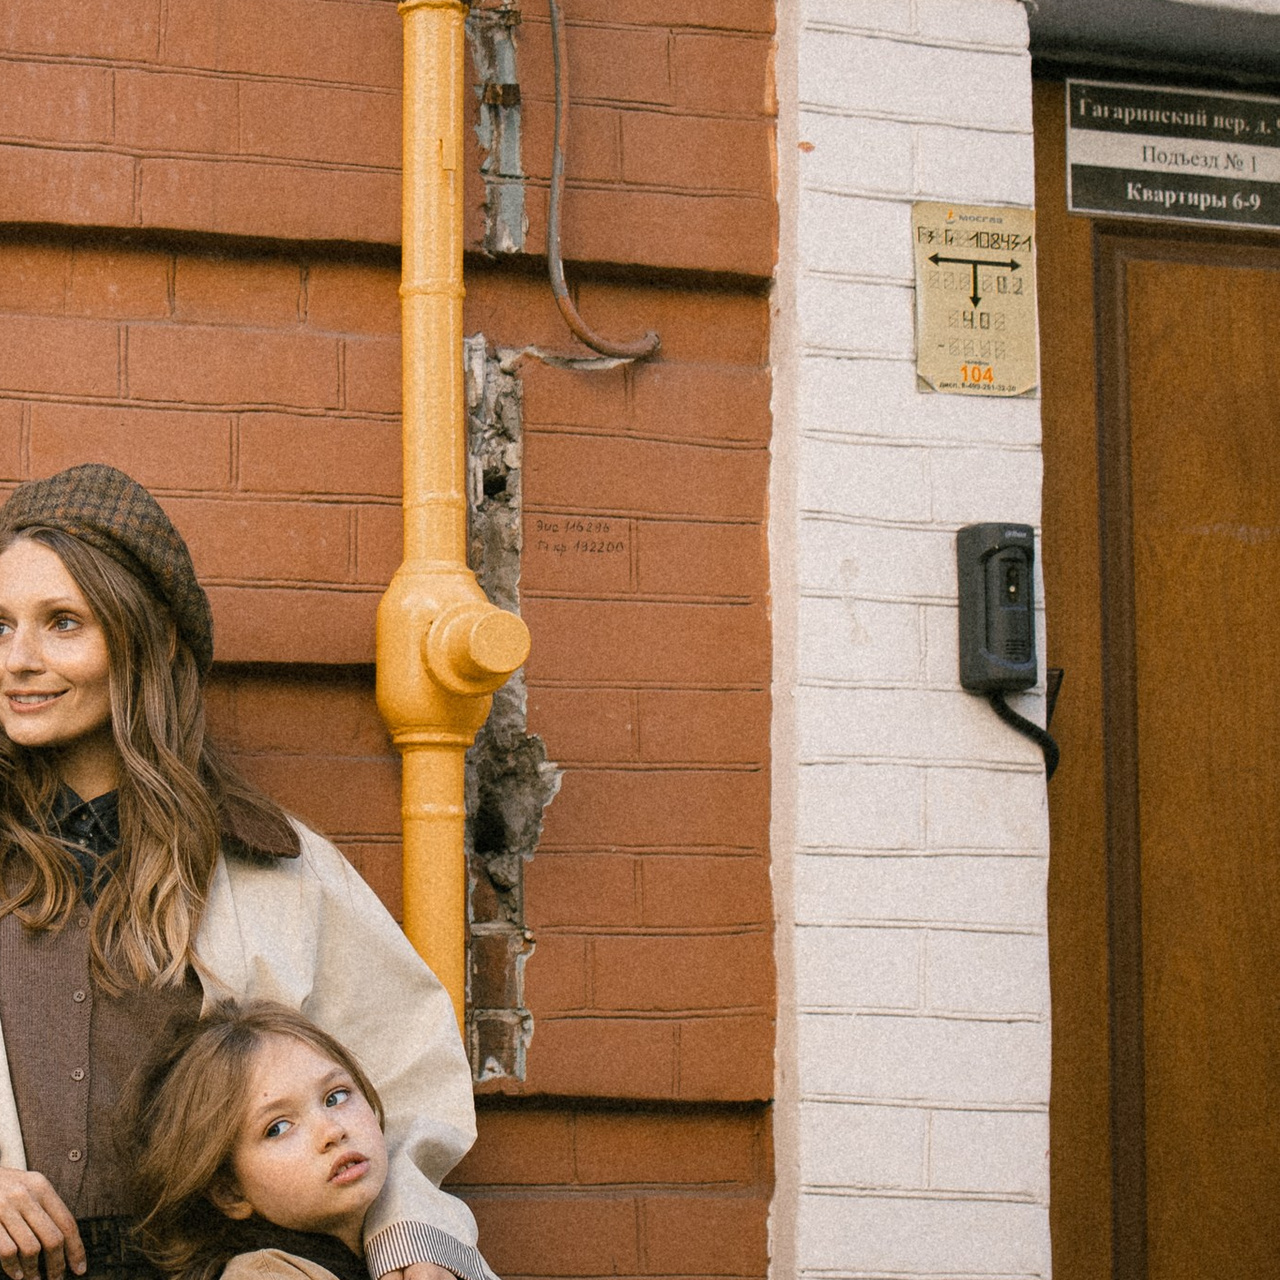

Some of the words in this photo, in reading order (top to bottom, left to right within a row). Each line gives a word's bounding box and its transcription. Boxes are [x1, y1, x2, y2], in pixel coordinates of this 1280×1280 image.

[1079, 98, 1207, 127] Гагаринский
[1213, 114, 1250, 135] пер.
[1142, 145, 1218, 169] Подъезд
[1223, 152, 1244, 171] №
[1250, 156, 1257, 173] 1
[1126, 181, 1227, 211] Квартиры
[1232, 191, 1261, 211] 6-9
[962, 310, 990, 329] 4.0
[960, 364, 994, 384] 104
